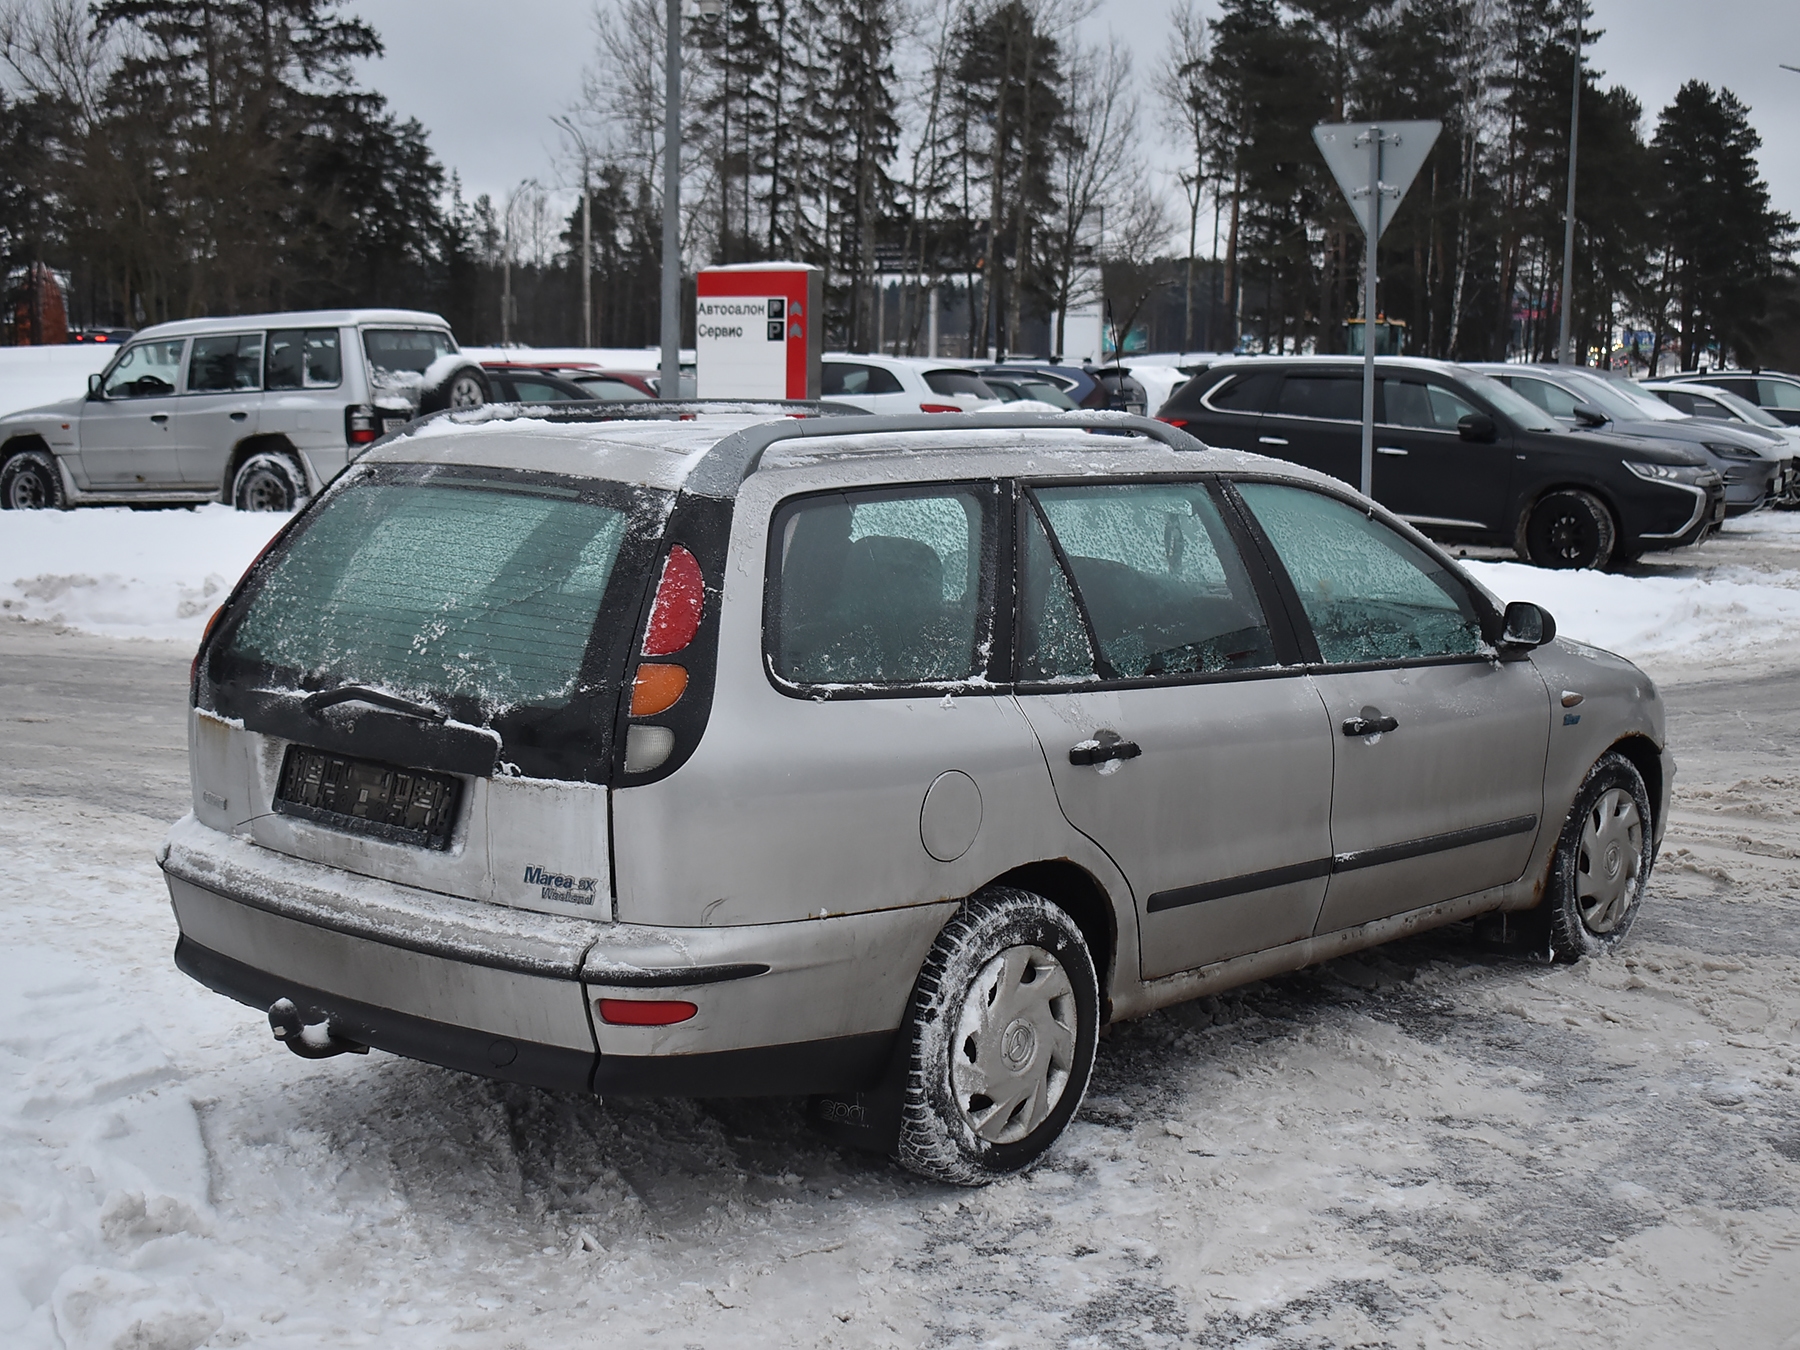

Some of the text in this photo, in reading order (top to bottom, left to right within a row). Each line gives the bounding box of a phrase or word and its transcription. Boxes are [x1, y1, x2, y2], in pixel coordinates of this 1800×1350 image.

[697, 302, 766, 315] Автосалон
[698, 324, 744, 340] Сервис
[523, 865, 574, 889] Marea
